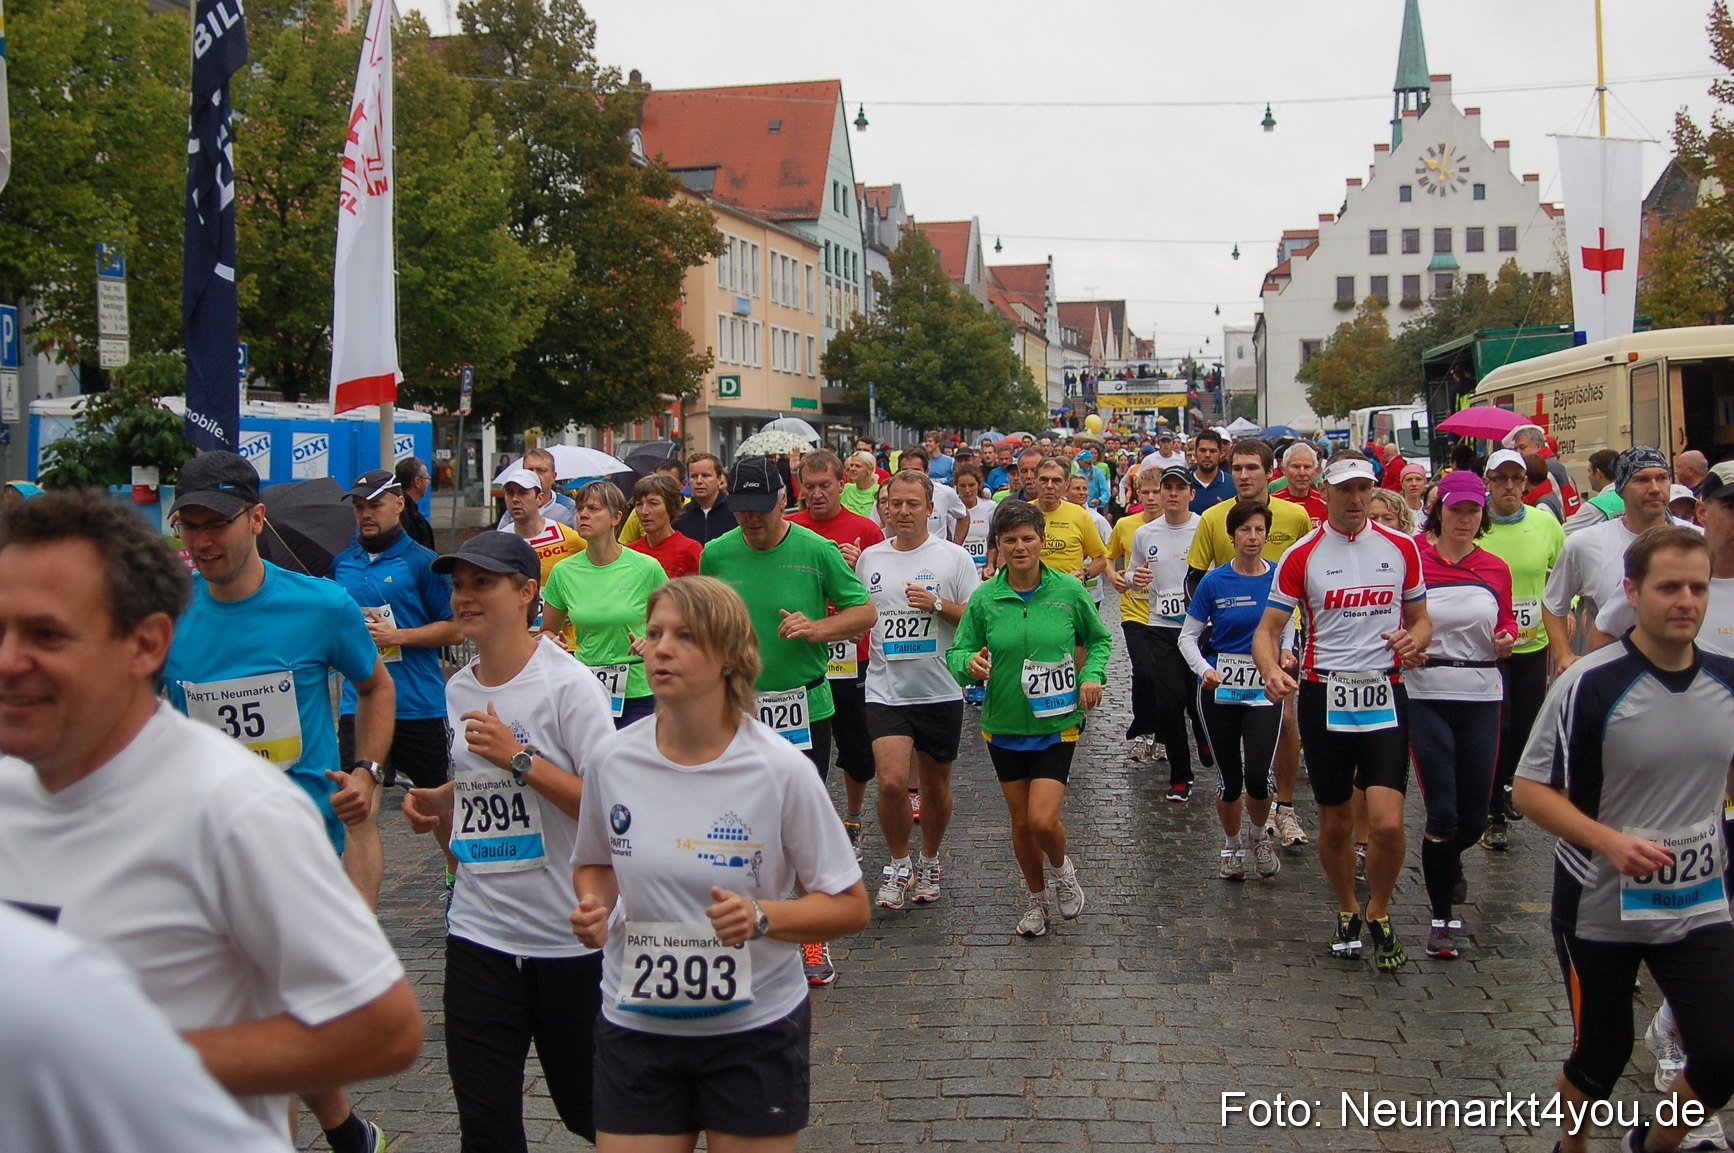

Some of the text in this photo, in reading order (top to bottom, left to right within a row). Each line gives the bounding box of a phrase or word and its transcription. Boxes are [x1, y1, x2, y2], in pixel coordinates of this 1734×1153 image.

[2, 314, 14, 360] P
[721, 378, 737, 394] D
[1126, 396, 1157, 406] START
[1553, 382, 1603, 411] Bayerisches
[1553, 413, 1577, 431] Rotes
[1323, 587, 1395, 611] Hako
[1343, 607, 1392, 618] Clean ahead
[884, 616, 932, 639] 2827
[893, 643, 922, 653] Patrick
[1028, 666, 1075, 695] 2706
[187, 685, 275, 702] PARTL Neumarkt
[762, 694, 796, 704] Neumarkt
[1045, 697, 1065, 708] Erika
[1334, 683, 1388, 708] 3108
[217, 701, 266, 739] 35
[471, 779, 512, 791] Neumarkt
[461, 792, 531, 834] 2394
[1663, 830, 1708, 848] Neumarkt
[471, 842, 517, 859] Claudia
[1633, 842, 1716, 885] 023
[1652, 890, 1699, 907] Roland
[627, 934, 661, 948] PARTL
[631, 953, 737, 1001] 2393
